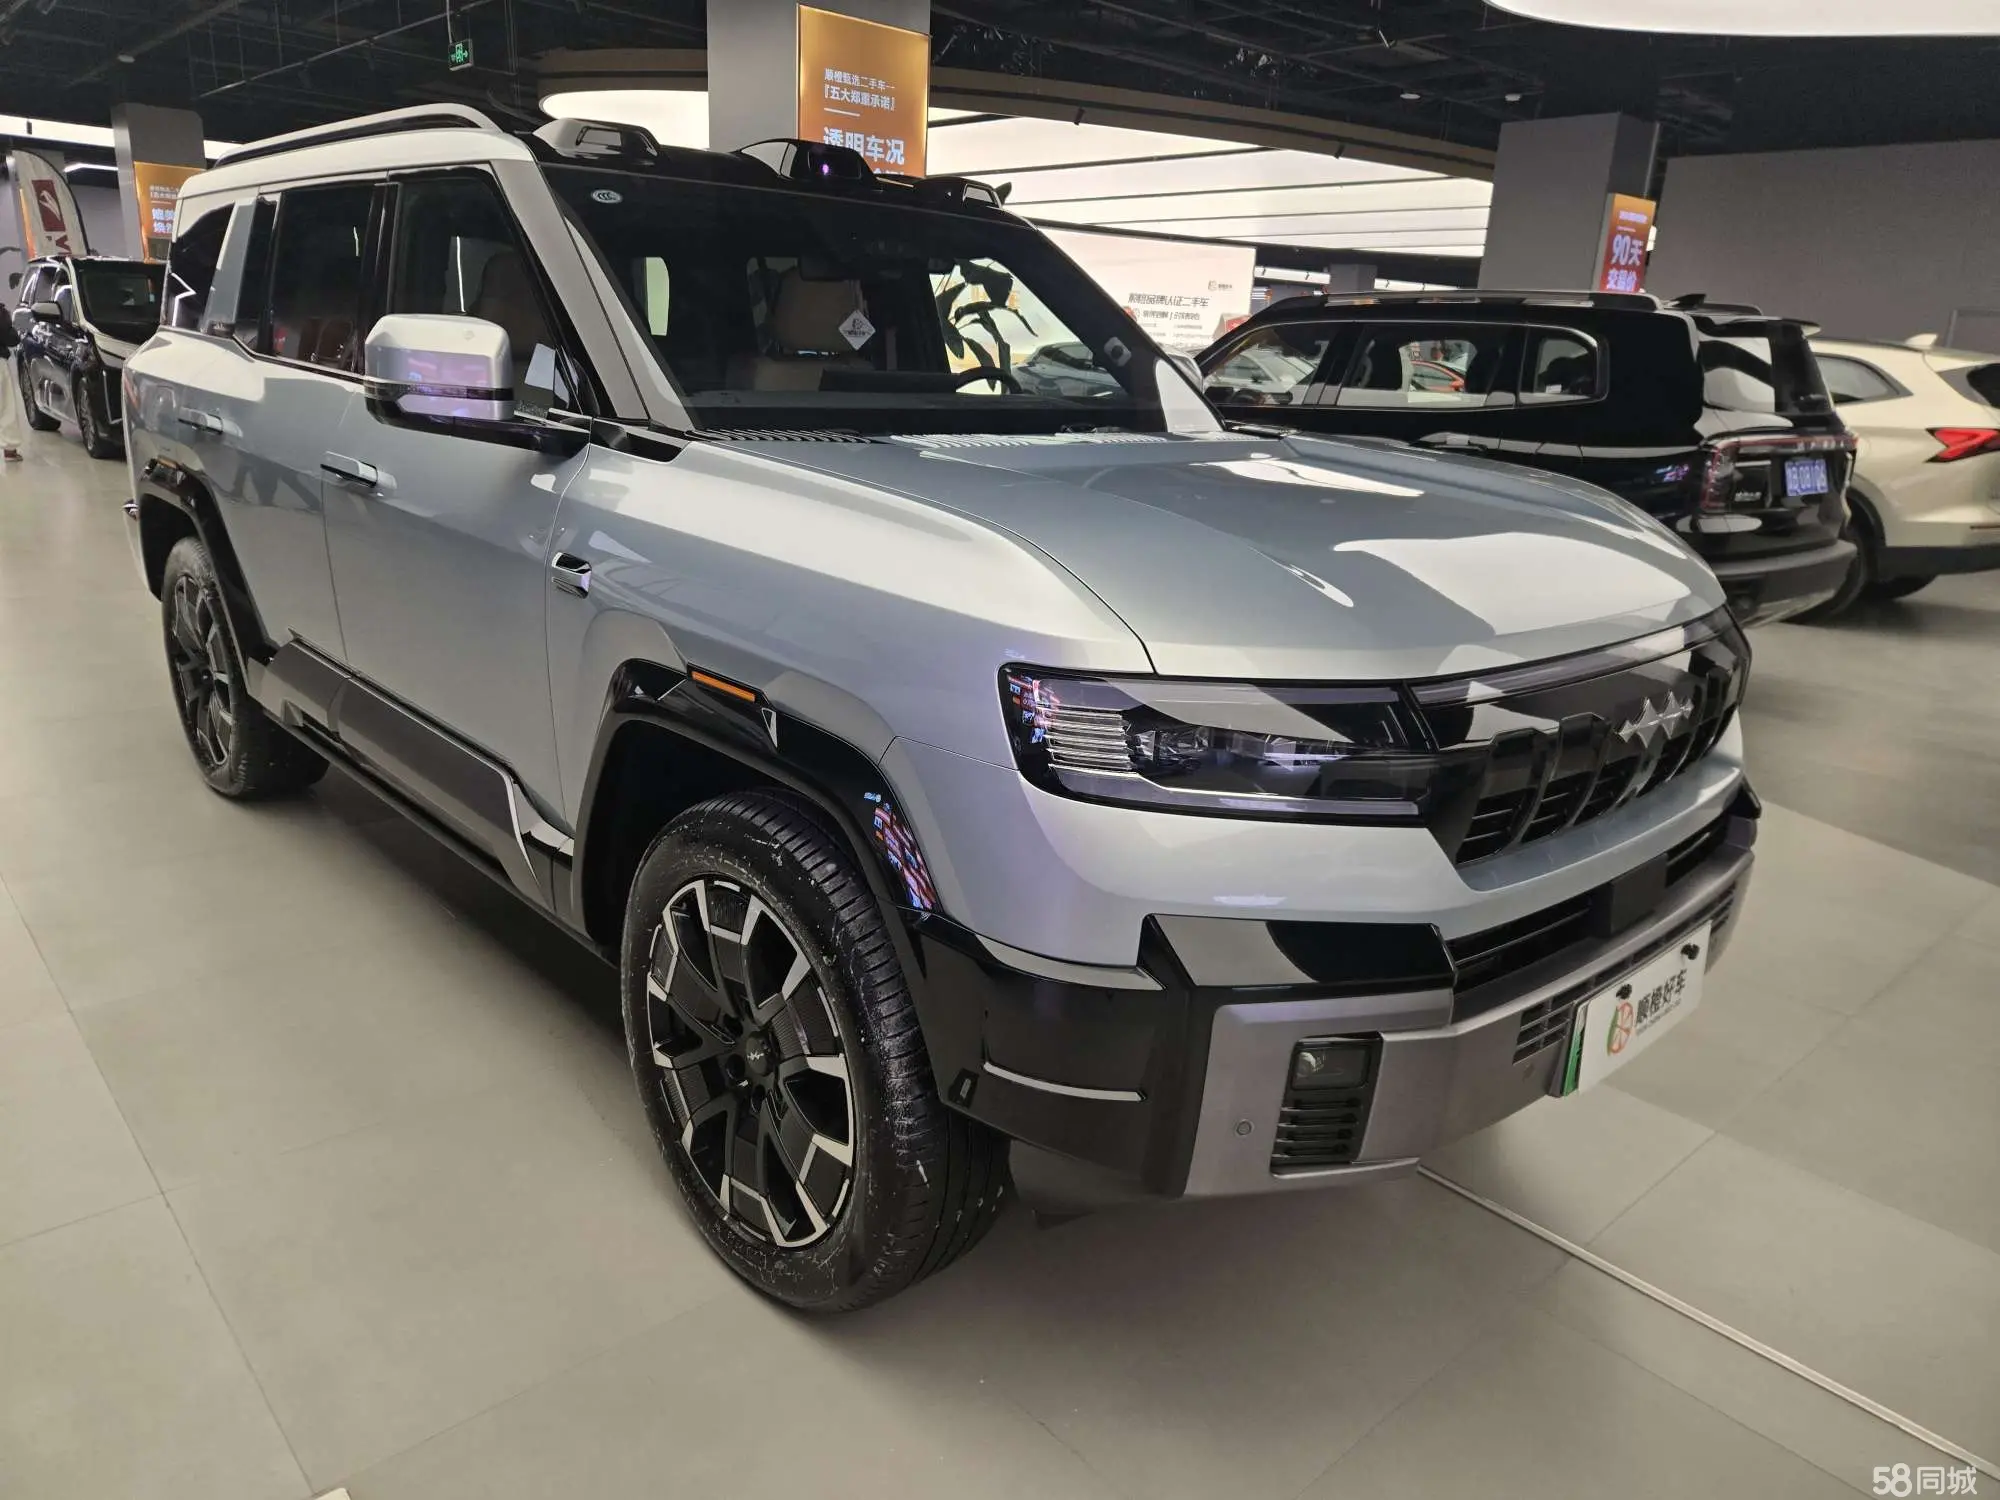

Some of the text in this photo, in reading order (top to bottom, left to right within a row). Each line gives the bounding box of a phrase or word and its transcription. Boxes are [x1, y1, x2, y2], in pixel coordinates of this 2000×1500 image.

[823, 127, 905, 165] 透明车况
[1611, 233, 1644, 266] 90天
